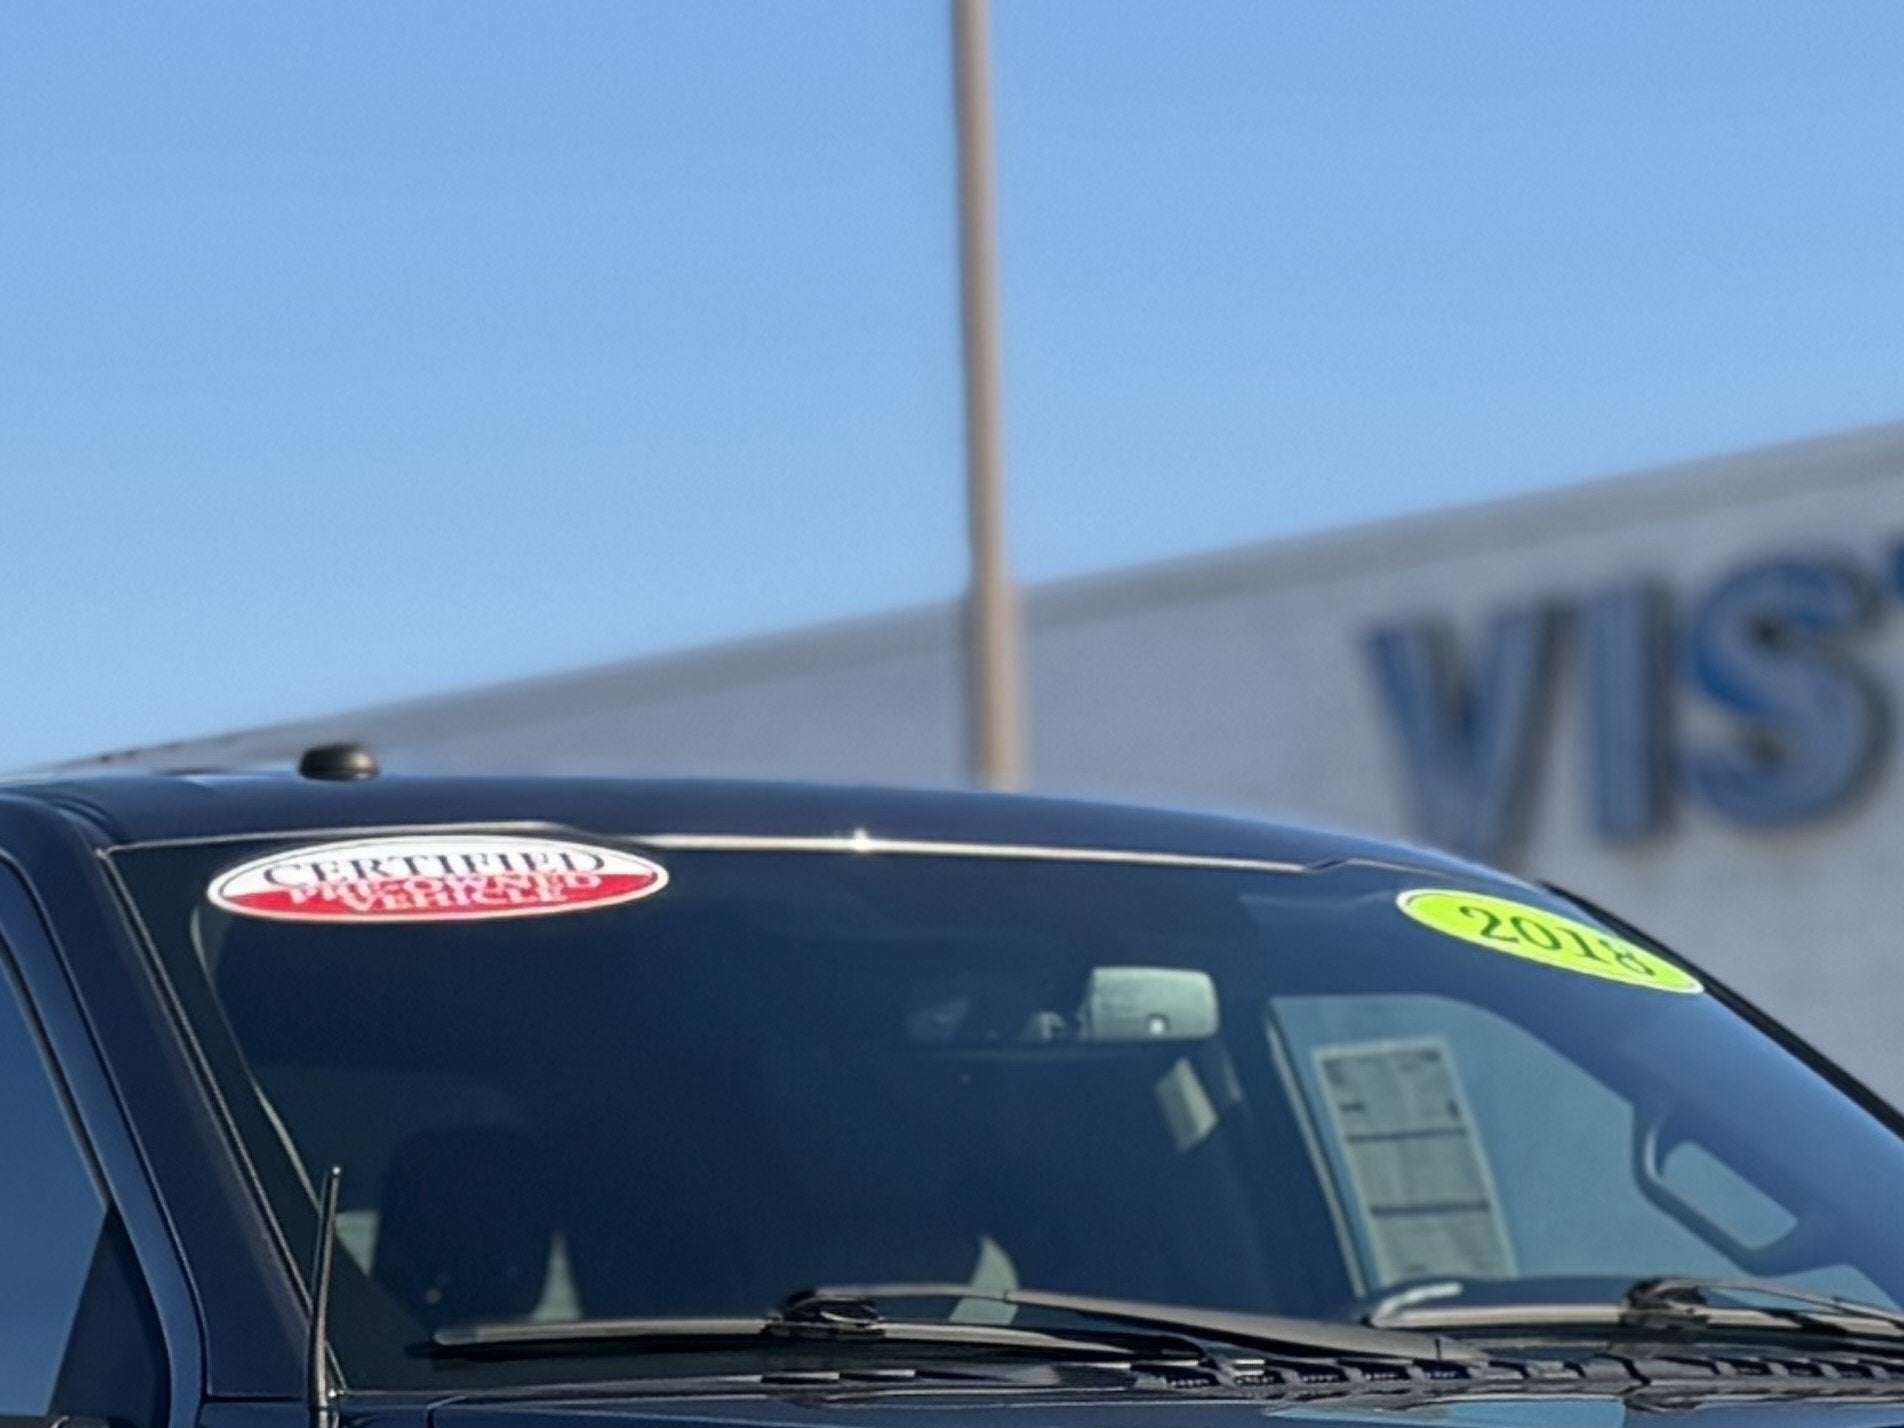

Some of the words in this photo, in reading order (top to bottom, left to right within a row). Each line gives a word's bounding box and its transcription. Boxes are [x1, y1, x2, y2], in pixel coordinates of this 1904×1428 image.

[262, 851, 606, 890] CERTIFIED
[342, 884, 568, 914] VEHICLE
[1457, 903, 1656, 977] 2018
